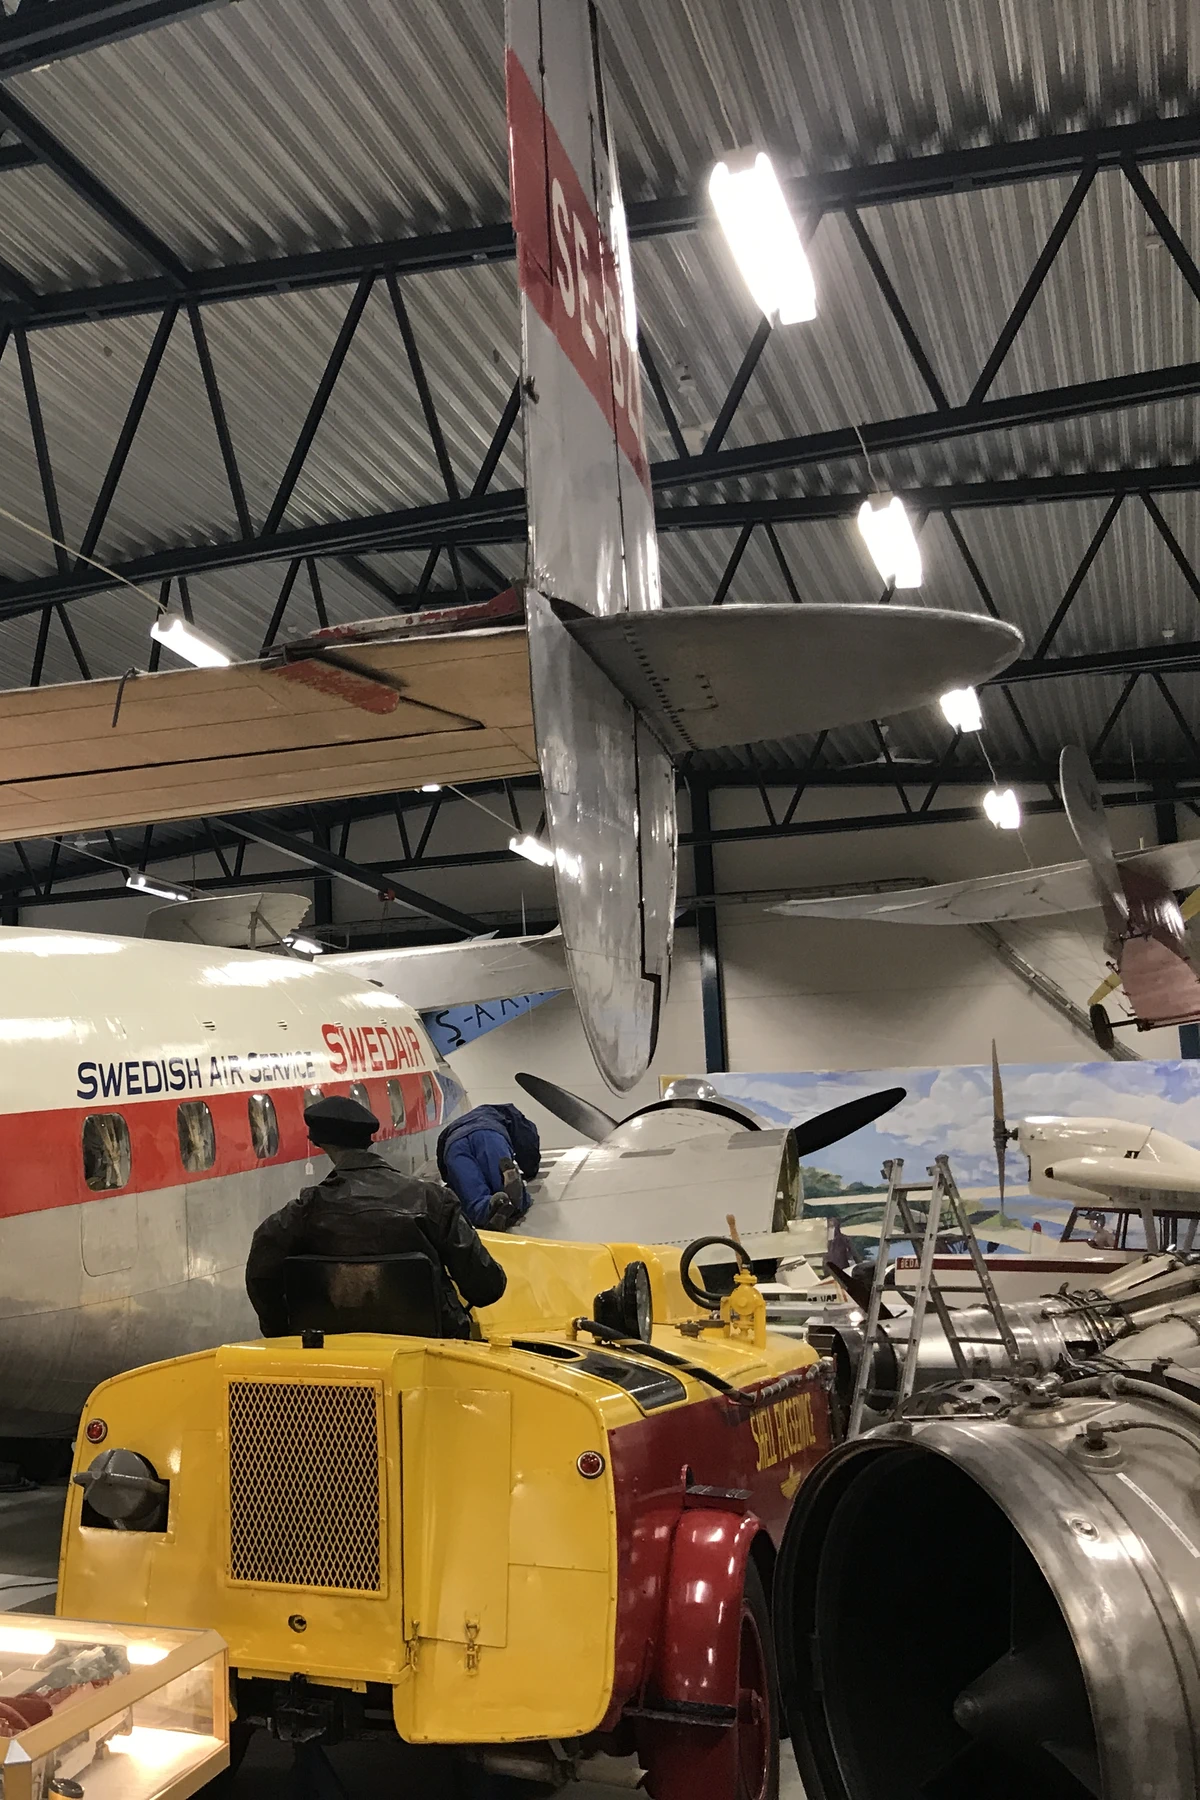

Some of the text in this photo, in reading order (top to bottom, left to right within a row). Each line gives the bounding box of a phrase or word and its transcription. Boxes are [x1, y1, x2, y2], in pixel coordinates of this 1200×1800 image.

[321, 1023, 426, 1075] SWEDAIR
[76, 1051, 317, 1100] SWEDISH AIR SERVICE
